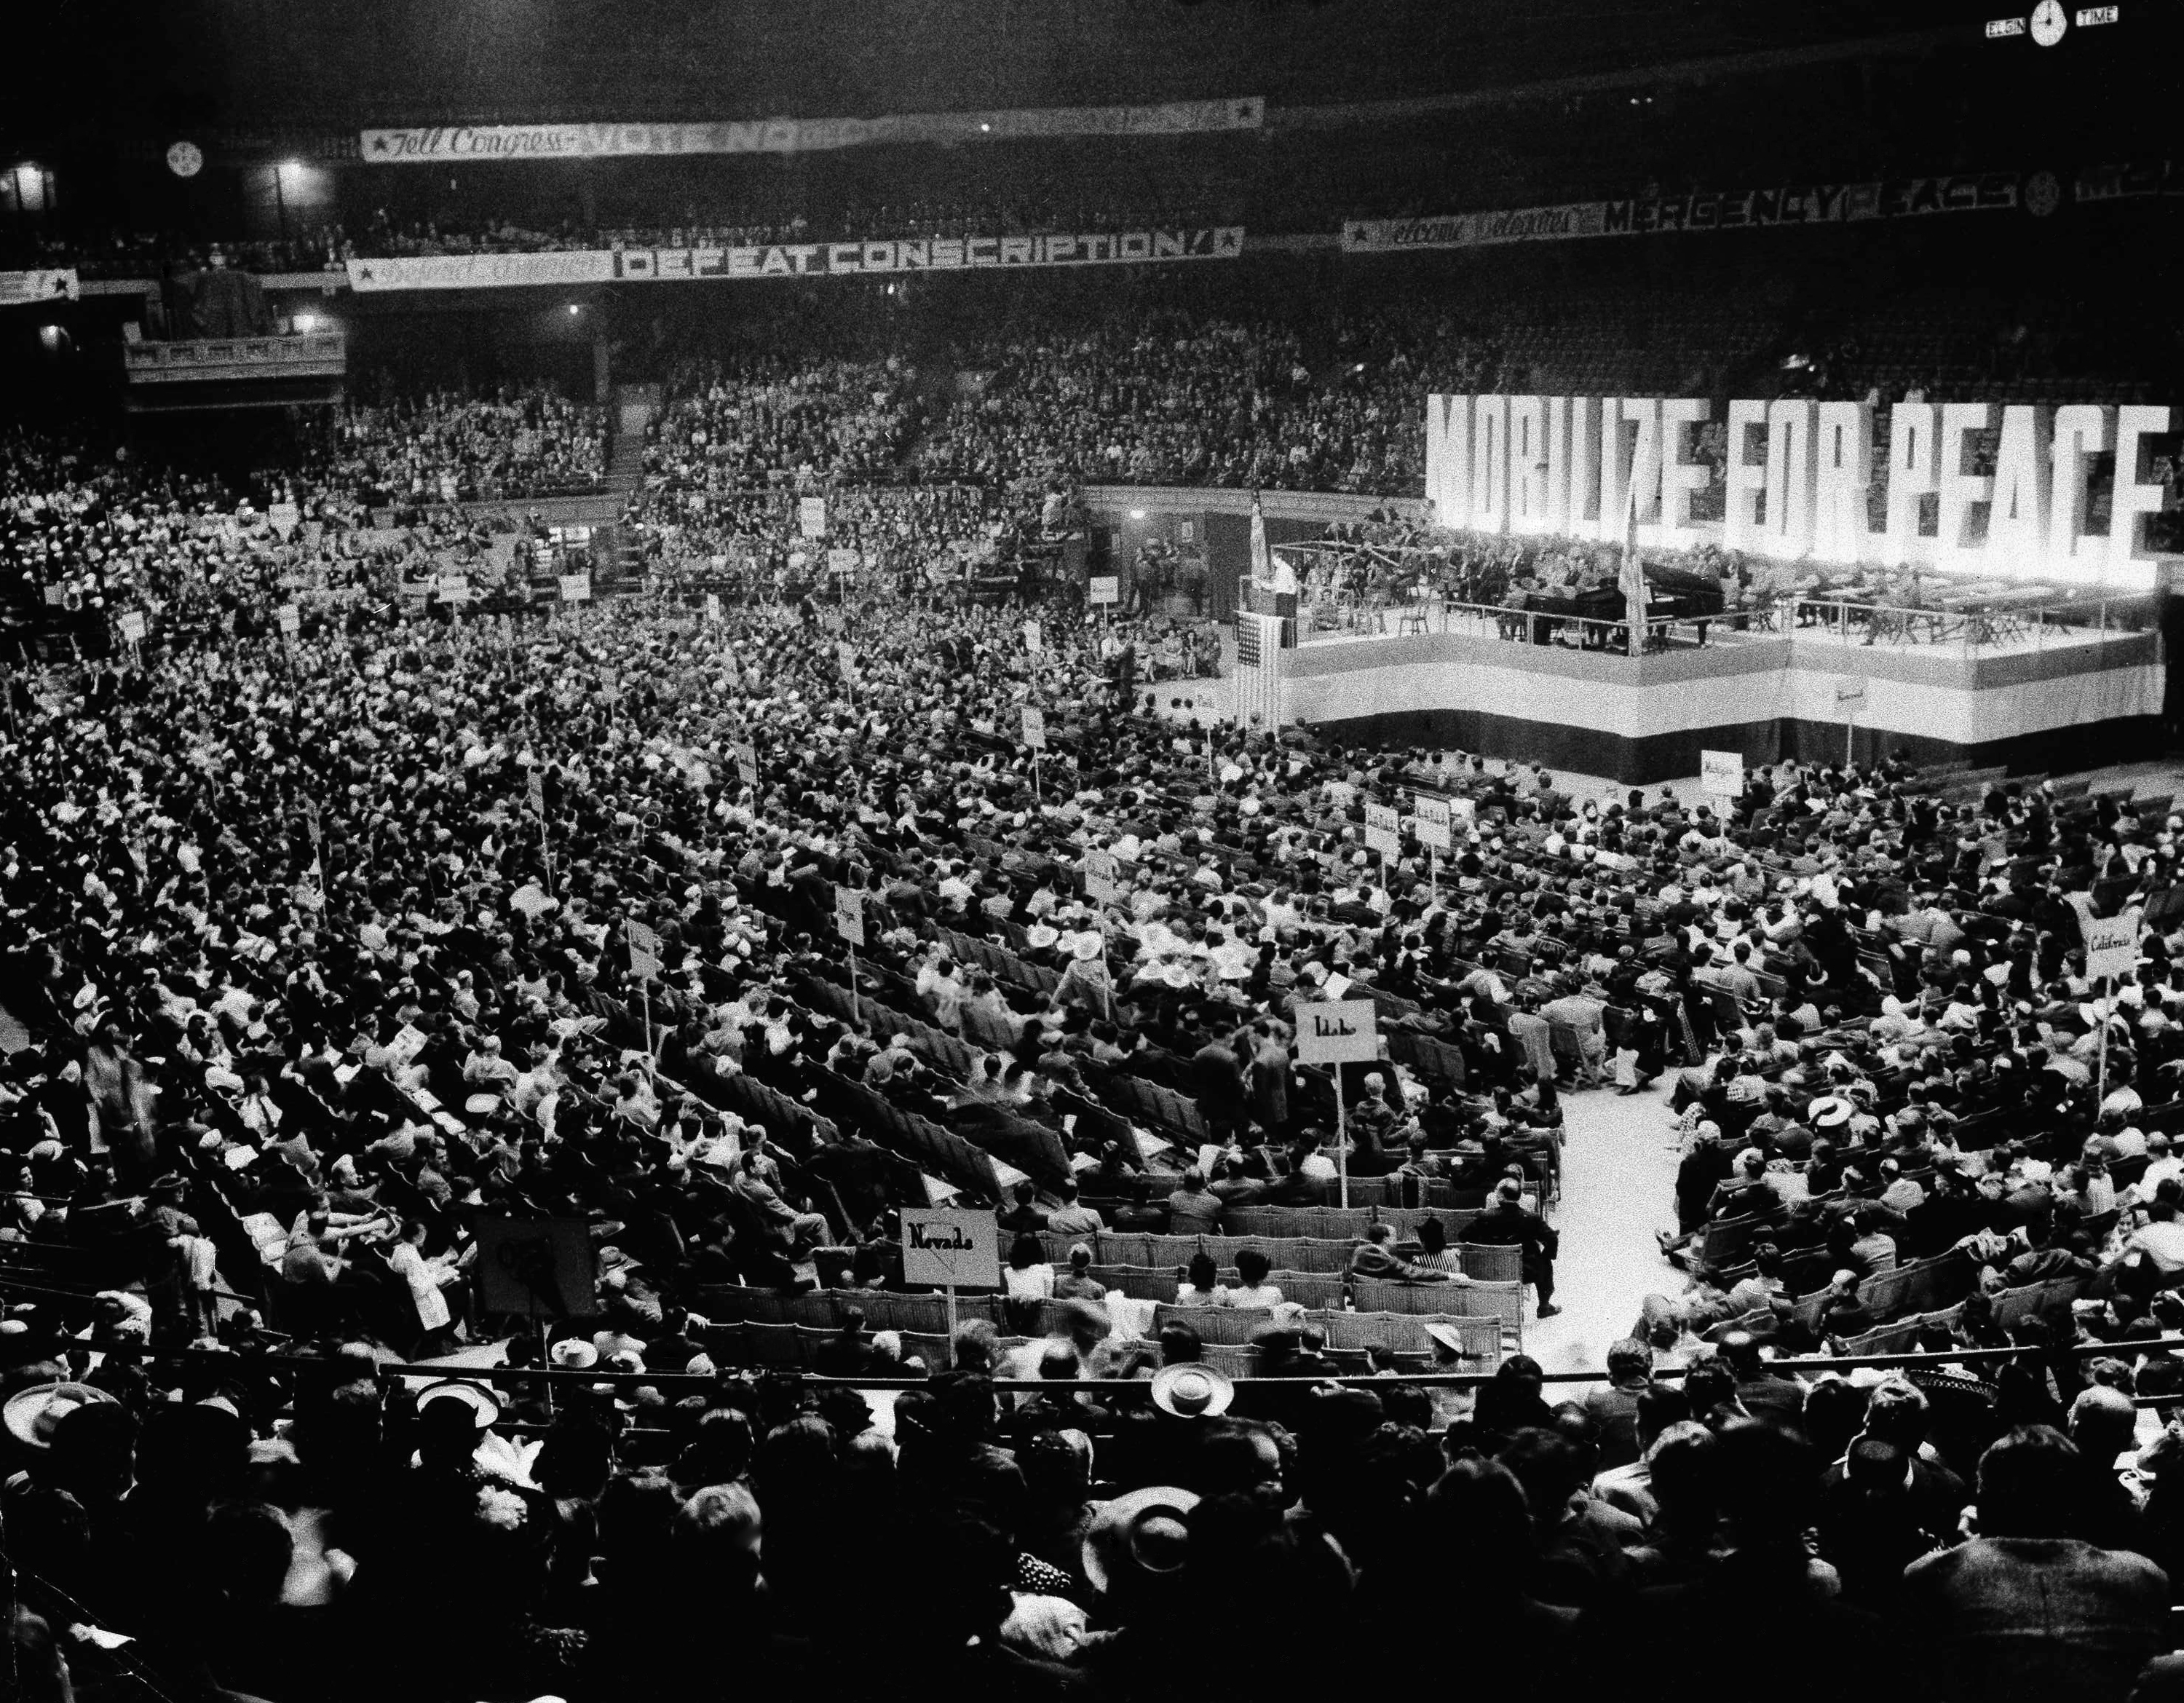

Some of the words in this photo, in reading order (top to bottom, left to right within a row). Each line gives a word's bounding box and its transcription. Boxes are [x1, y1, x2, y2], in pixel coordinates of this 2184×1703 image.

[2080, 7, 2115, 25] TIME
[394, 125, 442, 156] Tell
[621, 245, 818, 279] DEFEAT
[1426, 394, 1711, 550] MOBILIZE
[1724, 398, 1877, 561] FOR
[1887, 402, 2171, 590] PEACE
[1314, 1015, 1357, 1038] Idaho
[907, 1222, 973, 1250] Nevada
